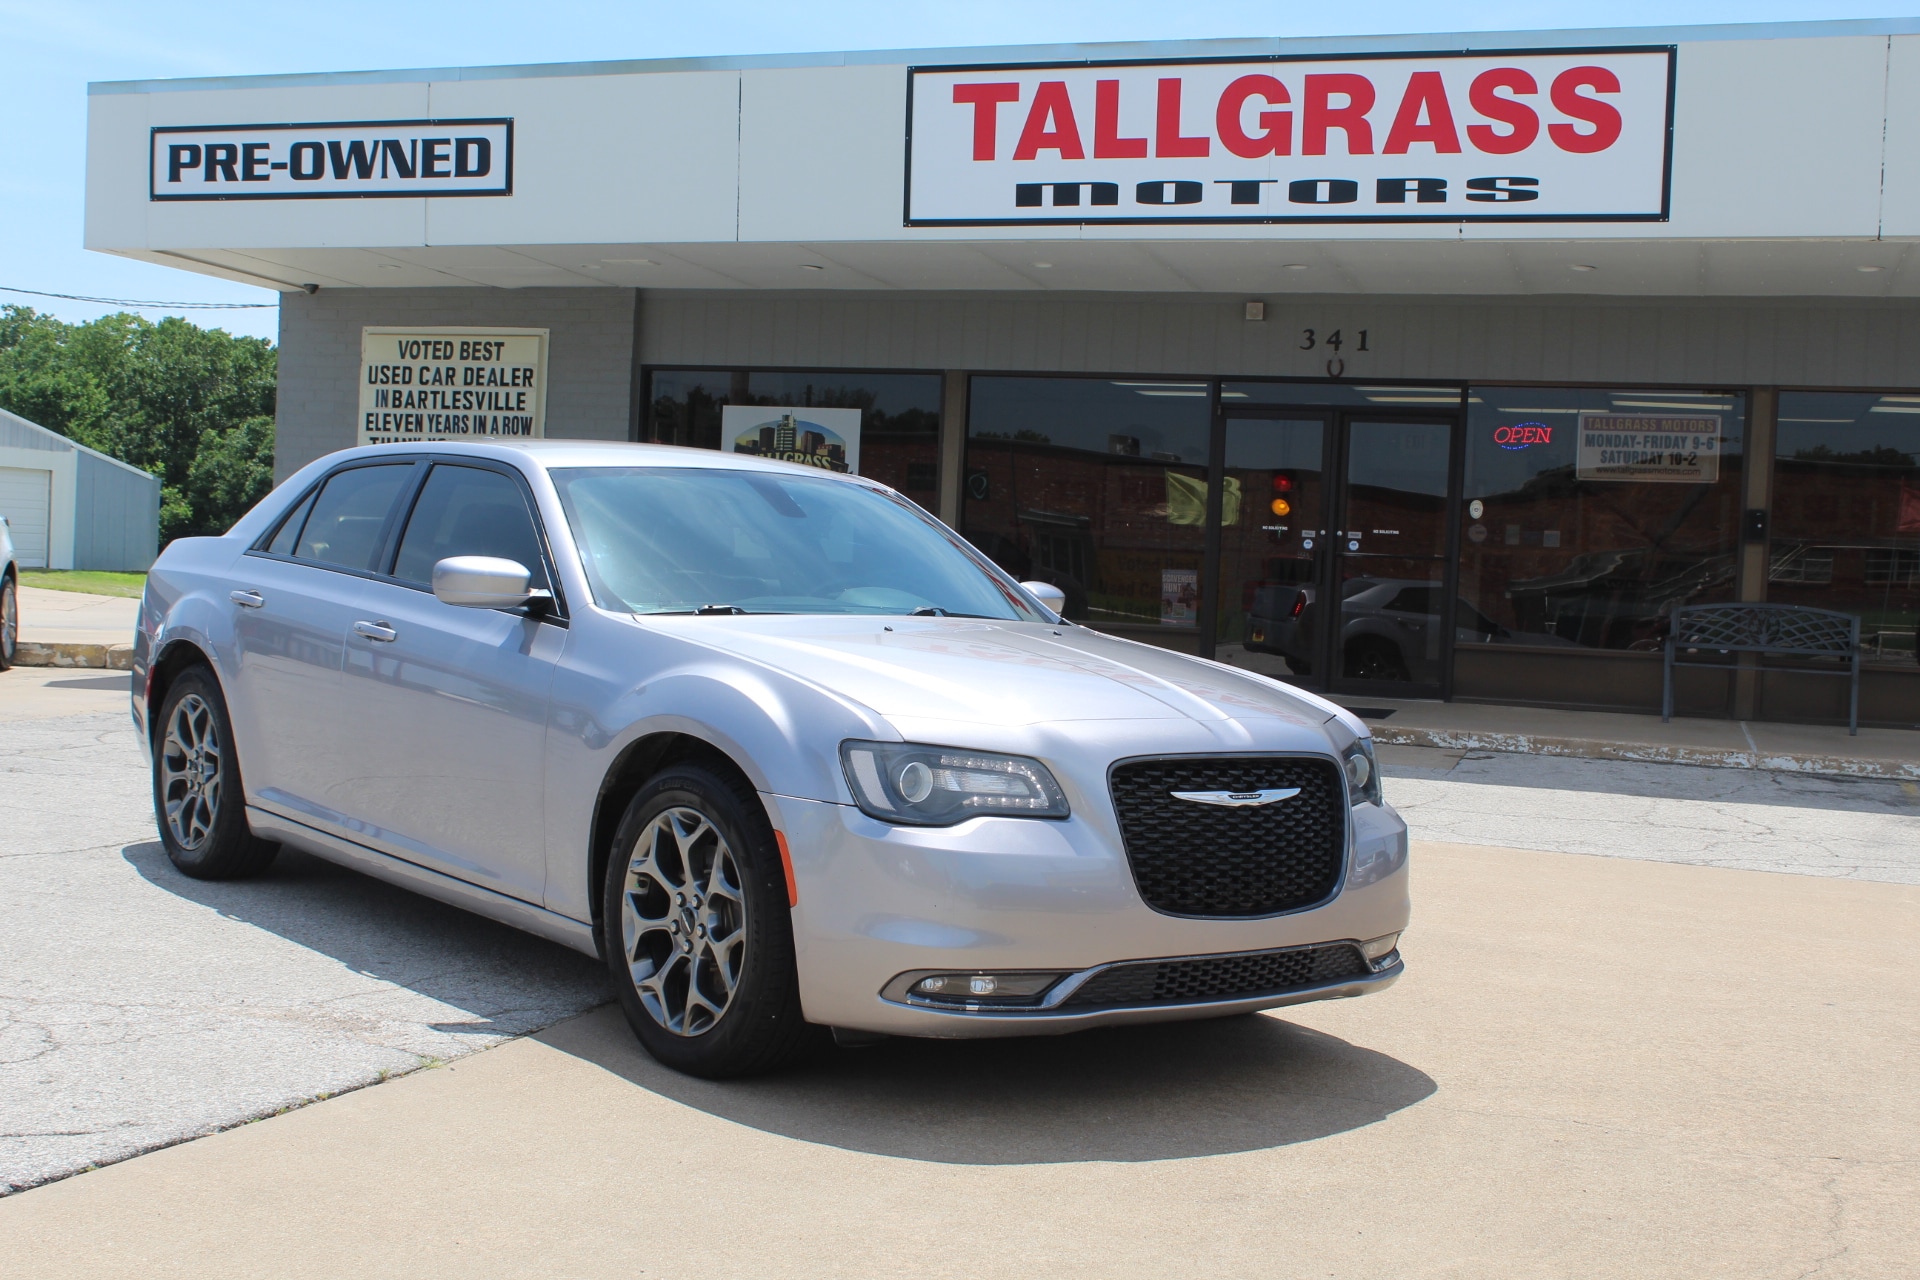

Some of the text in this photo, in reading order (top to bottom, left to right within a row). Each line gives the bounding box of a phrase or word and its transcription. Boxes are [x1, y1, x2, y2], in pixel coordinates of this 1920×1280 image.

[952, 66, 1623, 161] TALLGRASS
[168, 137, 492, 182] PRE-OWNED
[1015, 177, 1539, 207] MOTORS
[398, 340, 505, 361] VOTED BEST
[368, 365, 534, 387] USED CAR DEALER
[375, 389, 526, 411] IN BARTLESVILLE
[366, 413, 533, 435] ELEVEN YEARS IN A ROW
[1588, 418, 1714, 432] TALLGRASS MOTORS
[1494, 426, 1552, 443] OPEN
[1585, 434, 1714, 450] MONDAY-FRIDAY 9-6
[1600, 450, 1697, 466] SATURDAY 10-2
[1596, 466, 1701, 476] www.tallgrassmotors.com
[1162, 574, 1197, 583] SCAVENGER
[1163, 582, 1181, 592] HUNT
